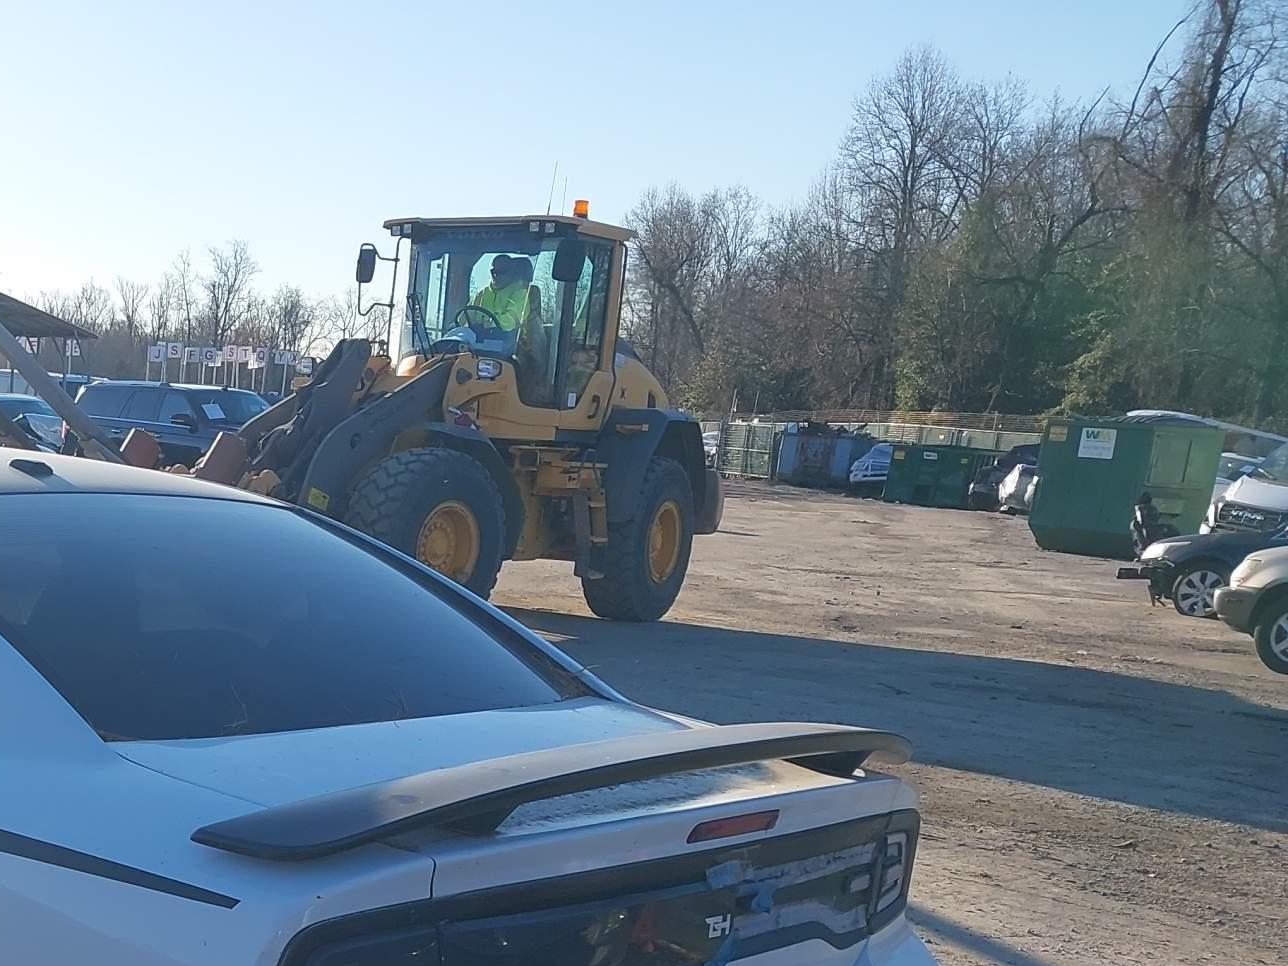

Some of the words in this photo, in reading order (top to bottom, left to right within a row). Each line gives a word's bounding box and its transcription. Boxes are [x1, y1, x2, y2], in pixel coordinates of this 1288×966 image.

[154, 349, 161, 359] J
[171, 345, 178, 356] S
[189, 350, 197, 360] F
[204, 350, 214, 360] G
[228, 347, 235, 358] S
[241, 348, 249, 358] T
